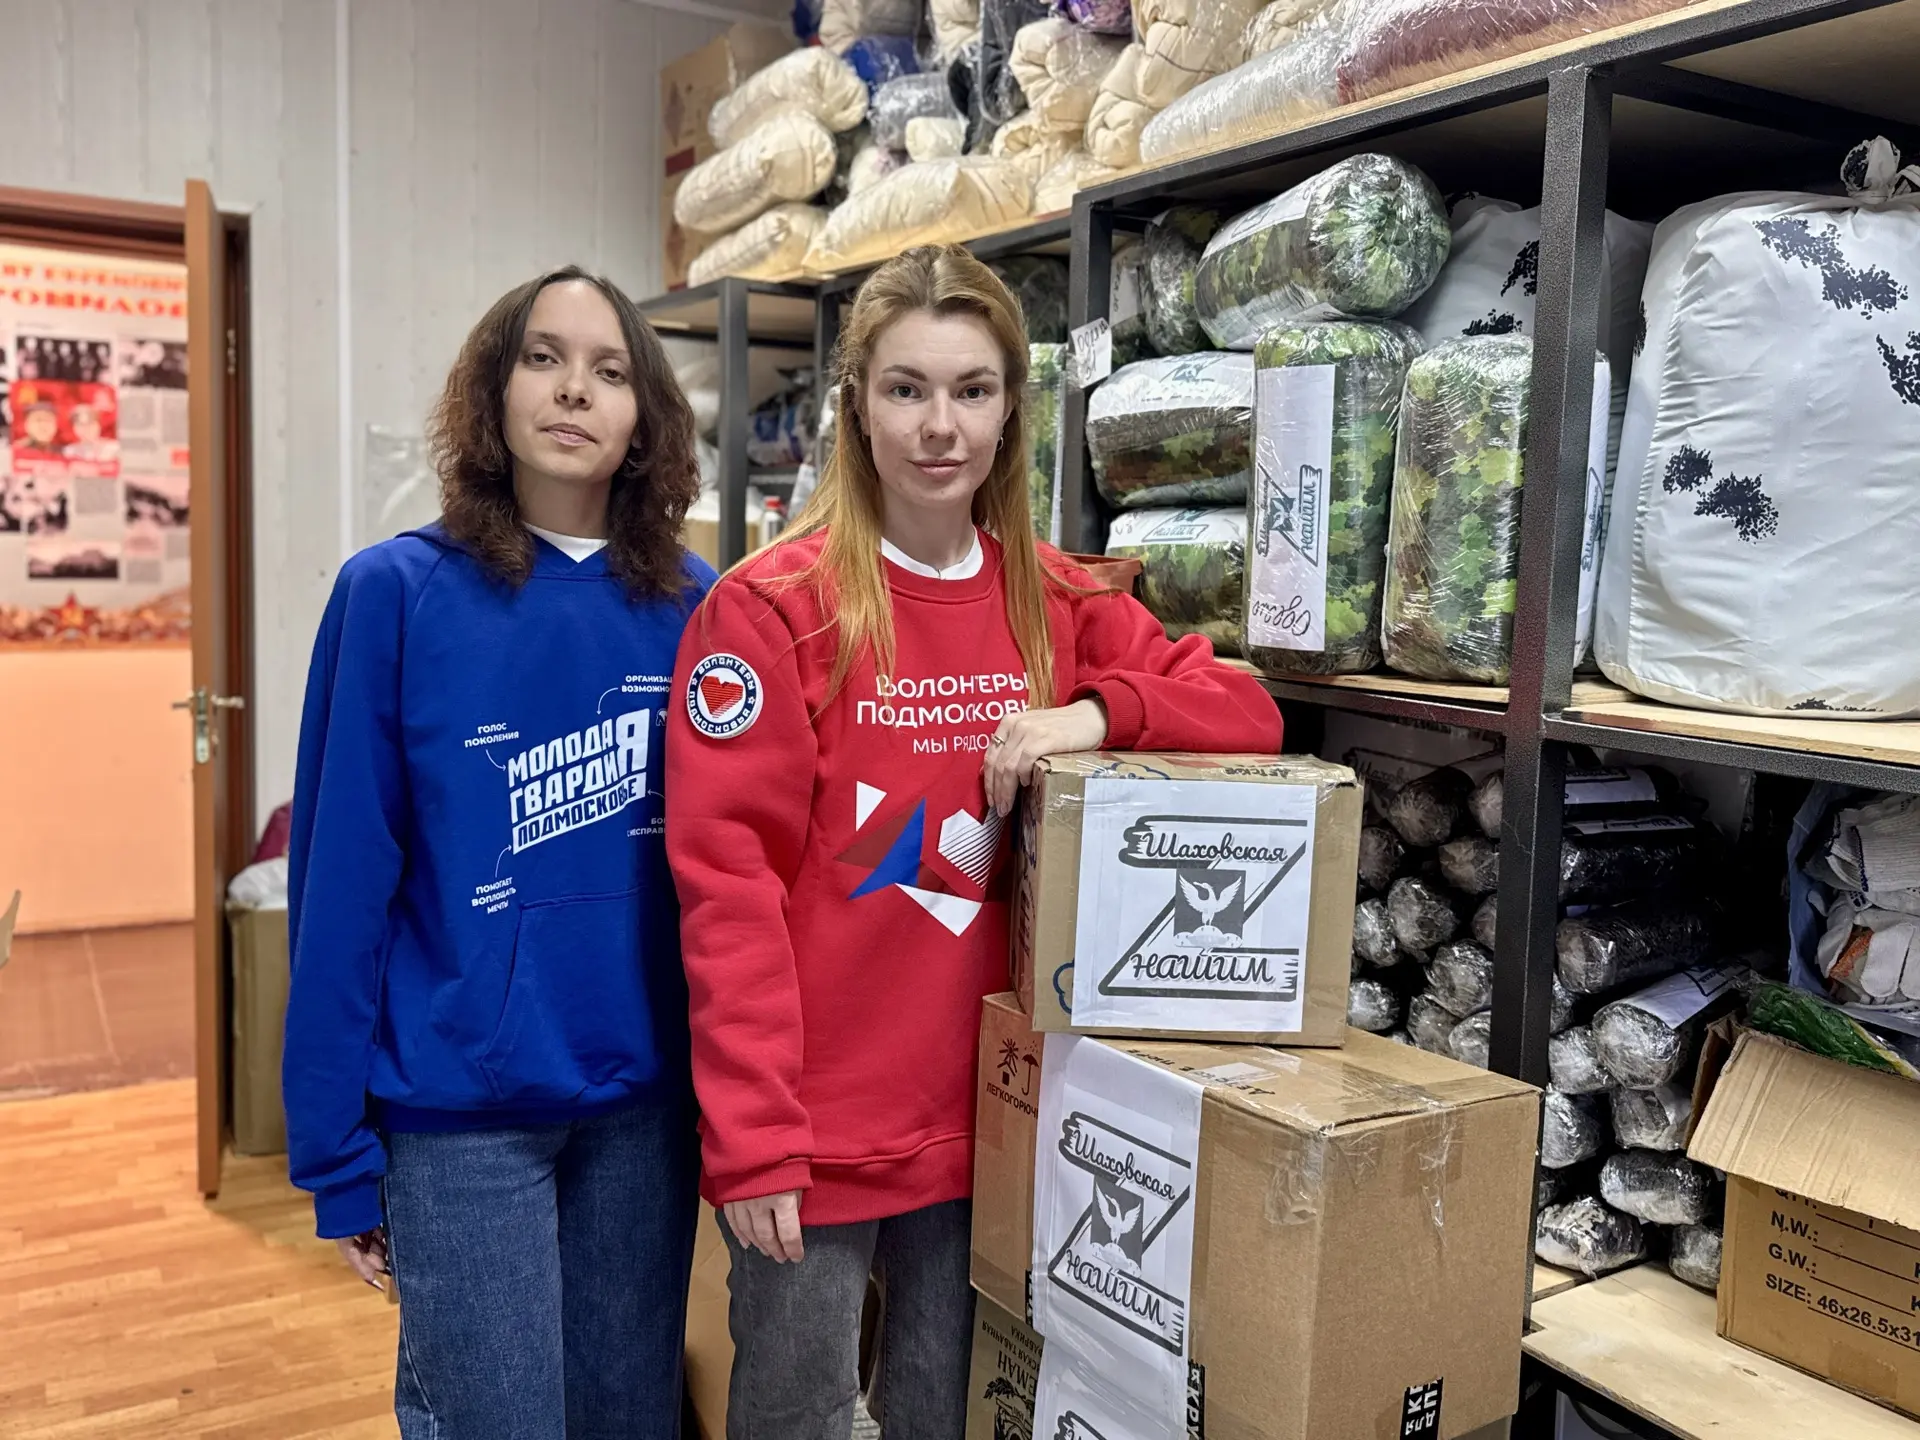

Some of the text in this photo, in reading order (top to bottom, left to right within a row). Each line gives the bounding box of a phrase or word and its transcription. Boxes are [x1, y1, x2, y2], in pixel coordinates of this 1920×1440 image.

[698, 656, 757, 690] ВОЛОНТЕРЫ
[621, 685, 671, 693] ВОЗМОЖНО
[464, 731, 519, 748] ПОКОЛЕНИЯ
[478, 722, 507, 735] ГОЛОС
[913, 733, 995, 754] МЫ РЯДО
[650, 817, 666, 825] БО
[1141, 832, 1289, 862] Шаховская
[475, 876, 513, 895] ПОМОГАЕТ
[487, 899, 509, 915] МЕЧТЫ
[1130, 951, 1275, 983] нашим
[1071, 1129, 1176, 1201] Шаховская
[1770, 1210, 1819, 1243] N.W.:
[1768, 1242, 1817, 1275] G.W.:
[1065, 1248, 1166, 1327] нашим
[1765, 1273, 1812, 1305] SIZE:
